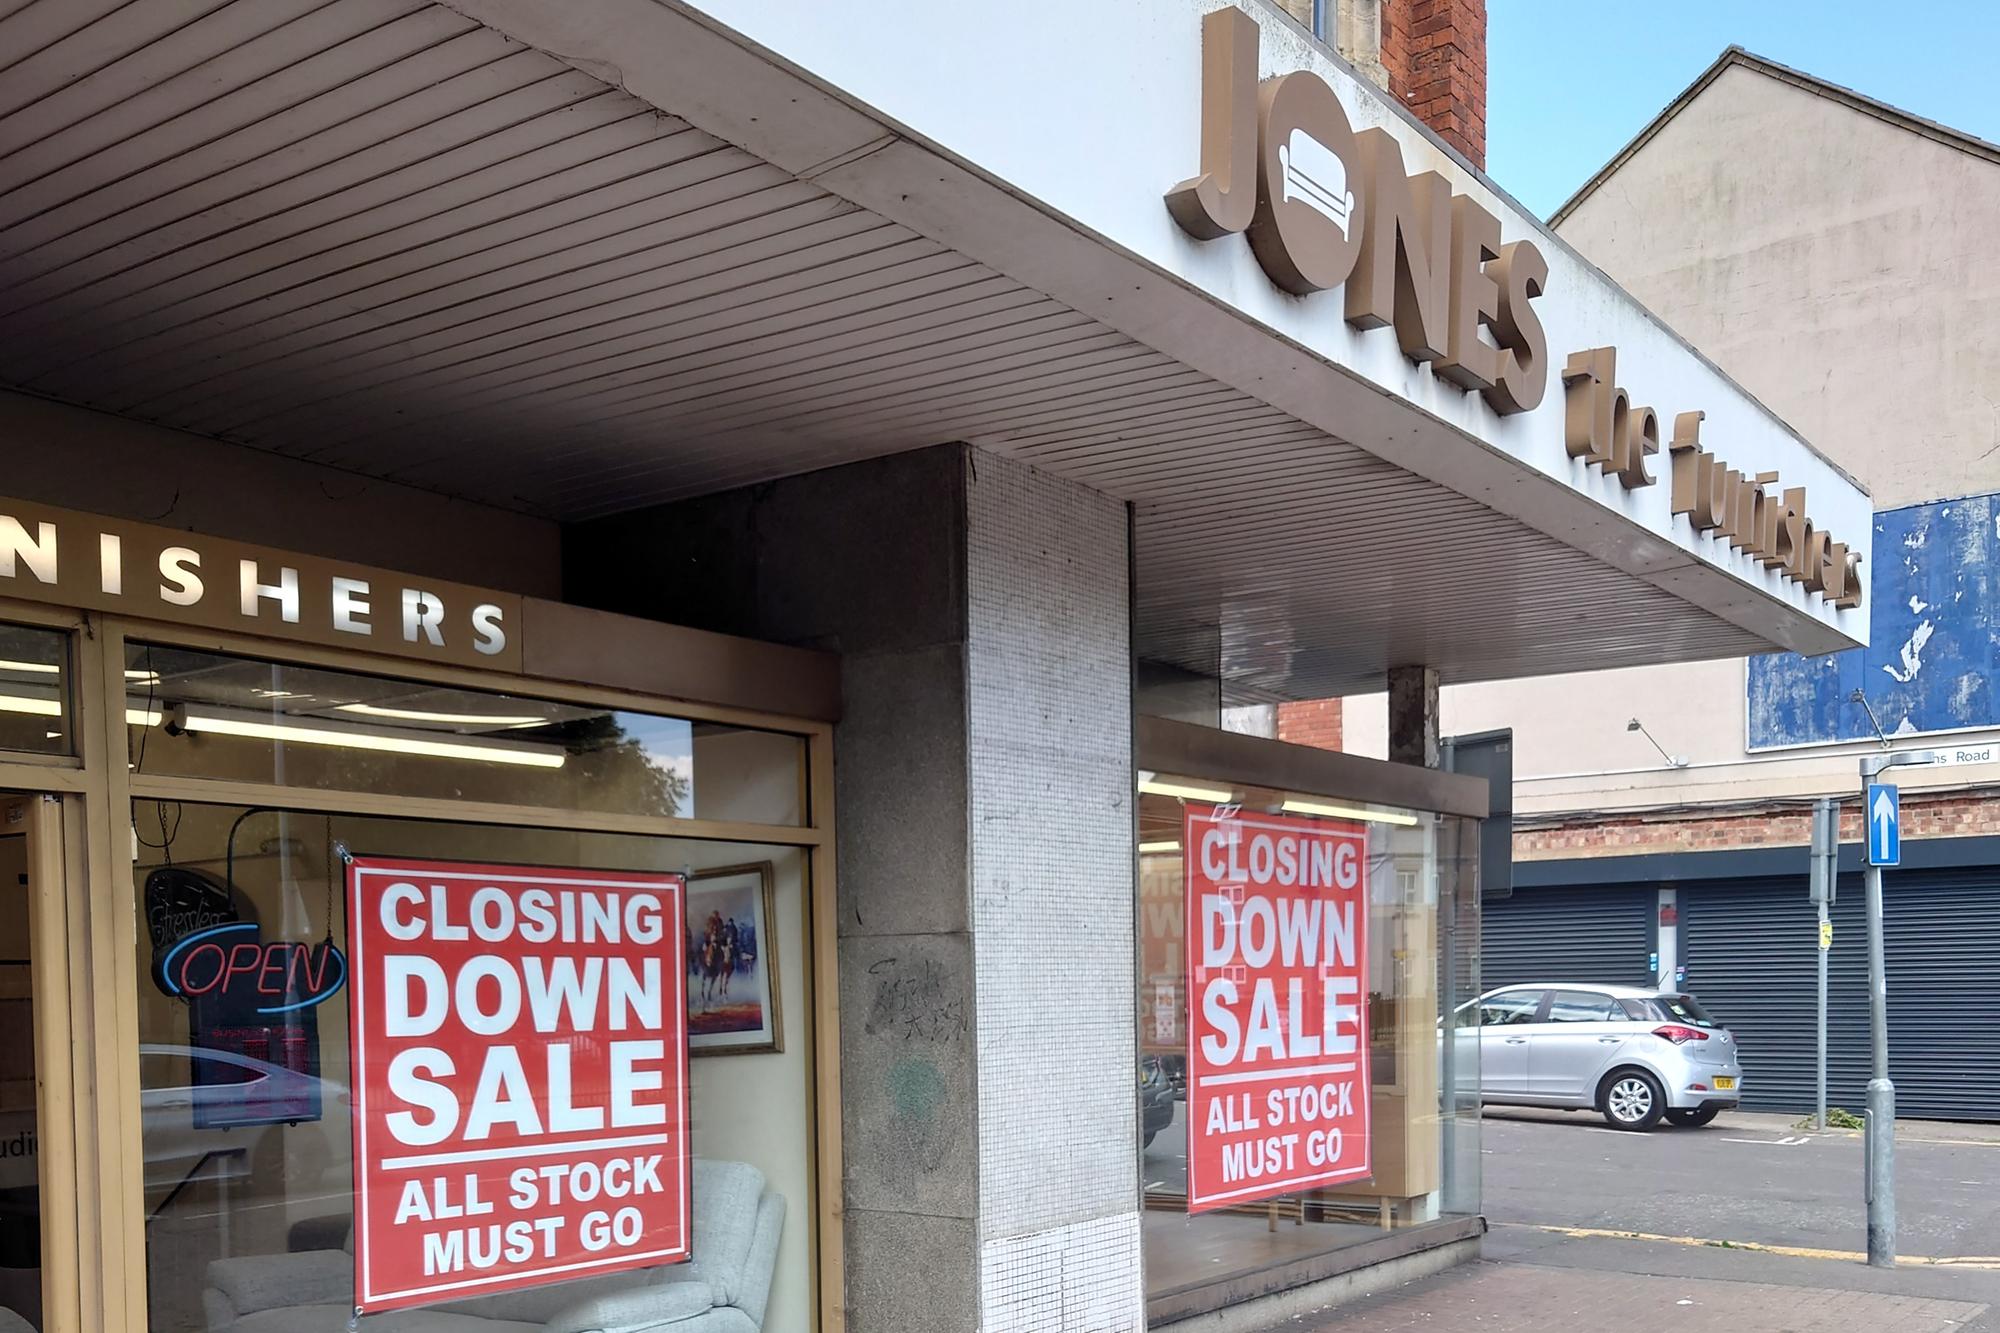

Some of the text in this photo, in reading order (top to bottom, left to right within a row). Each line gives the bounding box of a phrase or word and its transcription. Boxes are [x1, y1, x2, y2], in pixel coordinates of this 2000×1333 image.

[1163, 5, 1863, 610] JONES the furnishers
[0, 515, 506, 656] NISHERS
[1956, 749, 1990, 763] Road
[1201, 828, 1358, 889] CLOSING
[380, 882, 664, 945] CLOSING
[1202, 893, 1356, 968] DOWN
[181, 943, 329, 995] OPEN
[384, 954, 663, 1037] DOWN
[1201, 976, 1358, 1067] SALE
[385, 1040, 667, 1146] SALE
[1205, 1081, 1355, 1136] ALL STOCK
[394, 1154, 665, 1225] ALL STOCK
[1222, 1127, 1343, 1183] MUST GO
[423, 1206, 644, 1276] MUST GO
